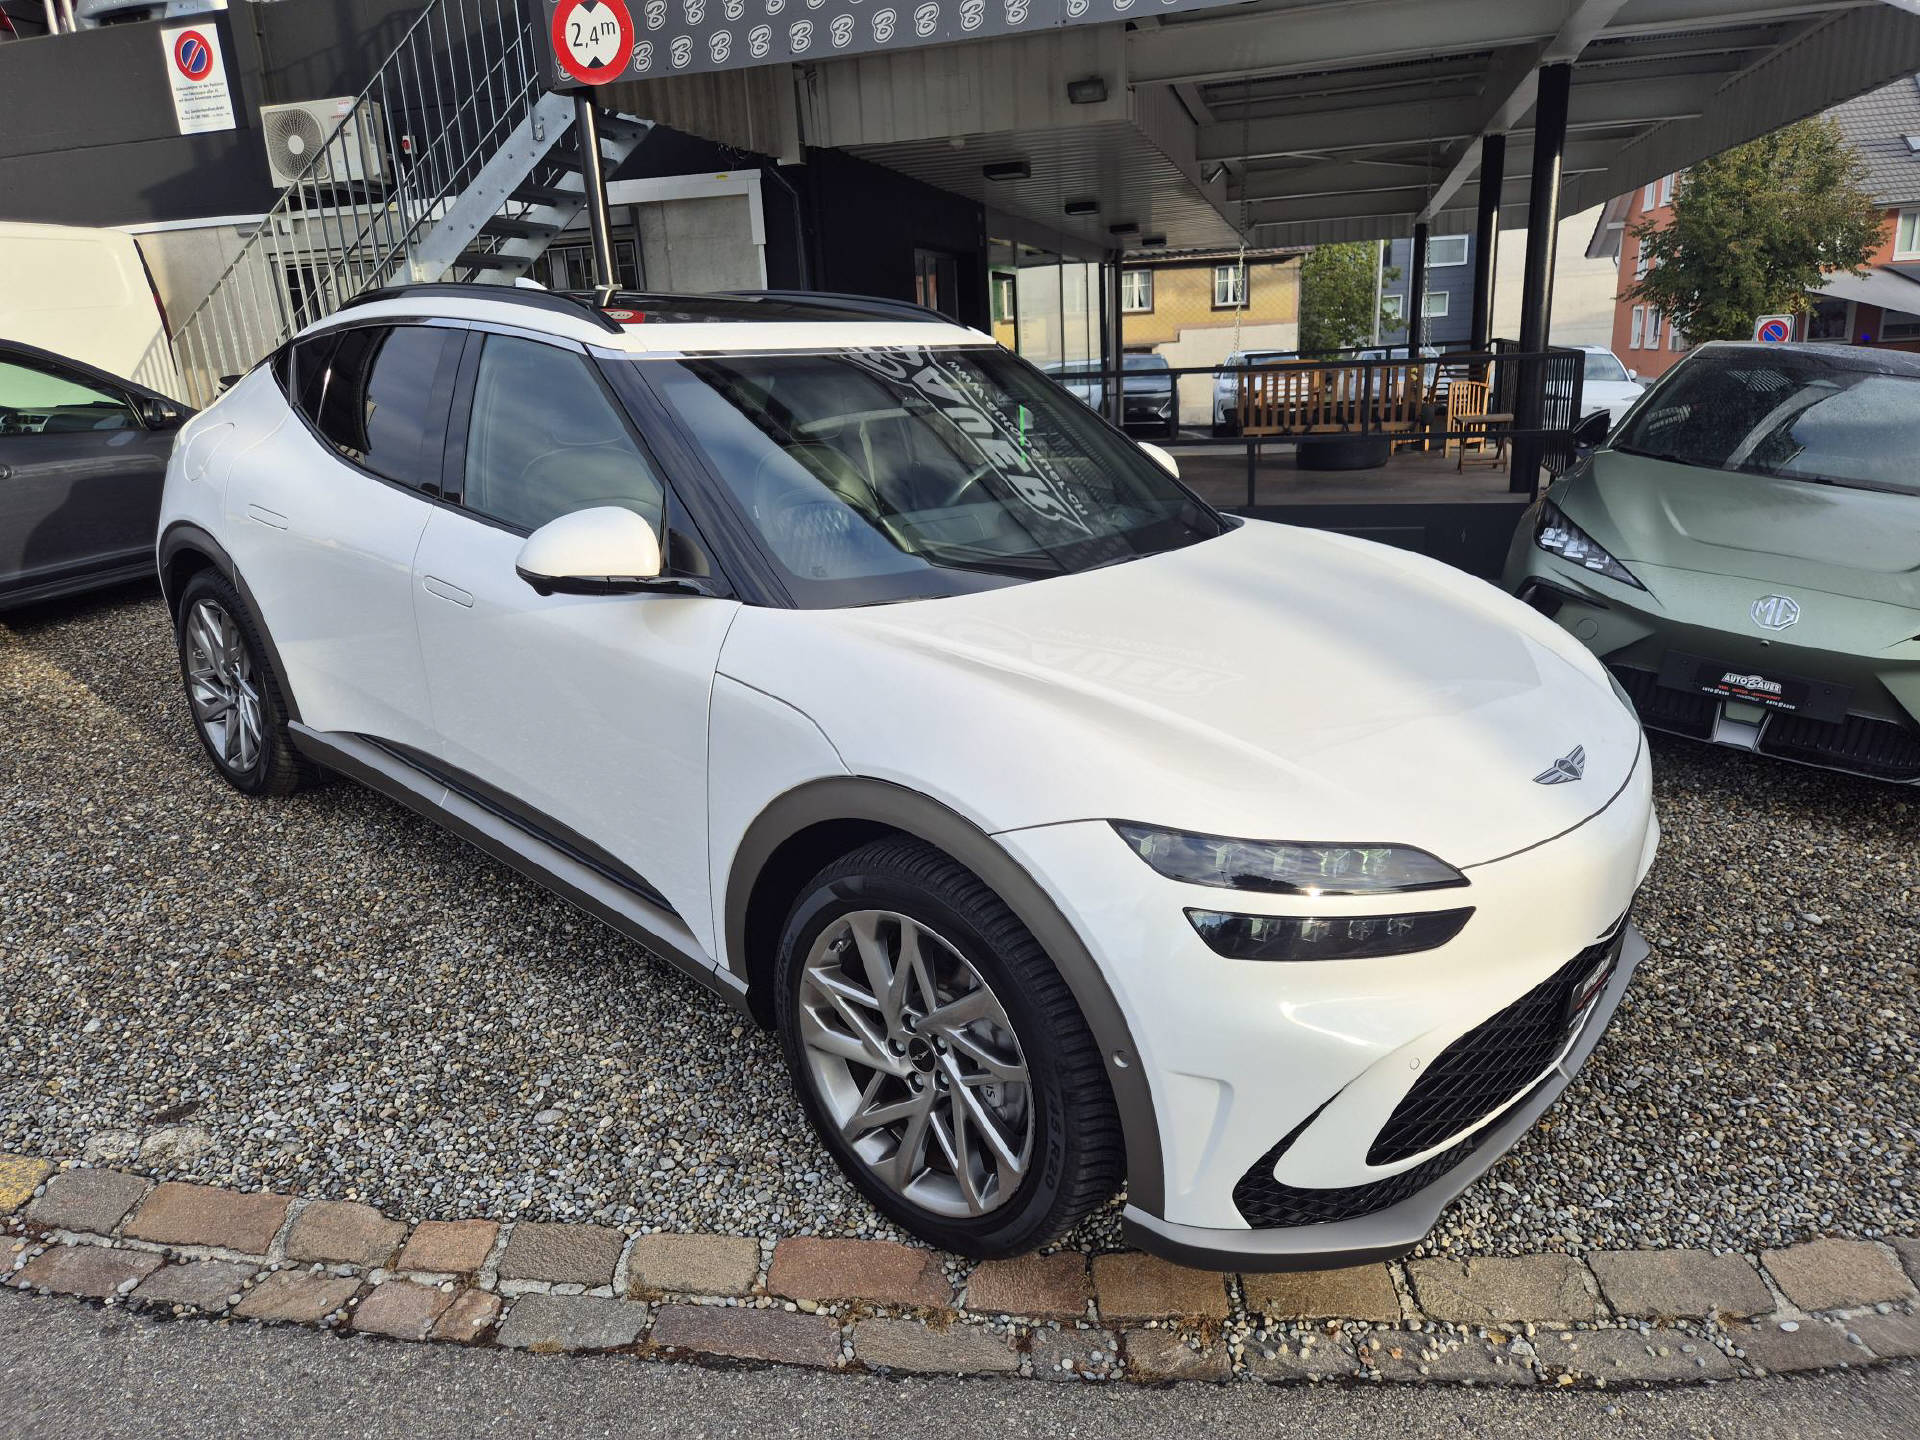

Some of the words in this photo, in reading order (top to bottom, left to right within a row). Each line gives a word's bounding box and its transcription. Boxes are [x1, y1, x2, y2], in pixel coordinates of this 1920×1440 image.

[633, 41, 653, 72] B
[671, 35, 693, 68] B
[709, 29, 732, 63] B
[748, 24, 771, 58] B
[789, 20, 813, 53] B
[830, 14, 854, 48] B
[872, 8, 896, 43] B
[914, 2, 940, 37] B
[1752, 597, 1798, 627] MG
